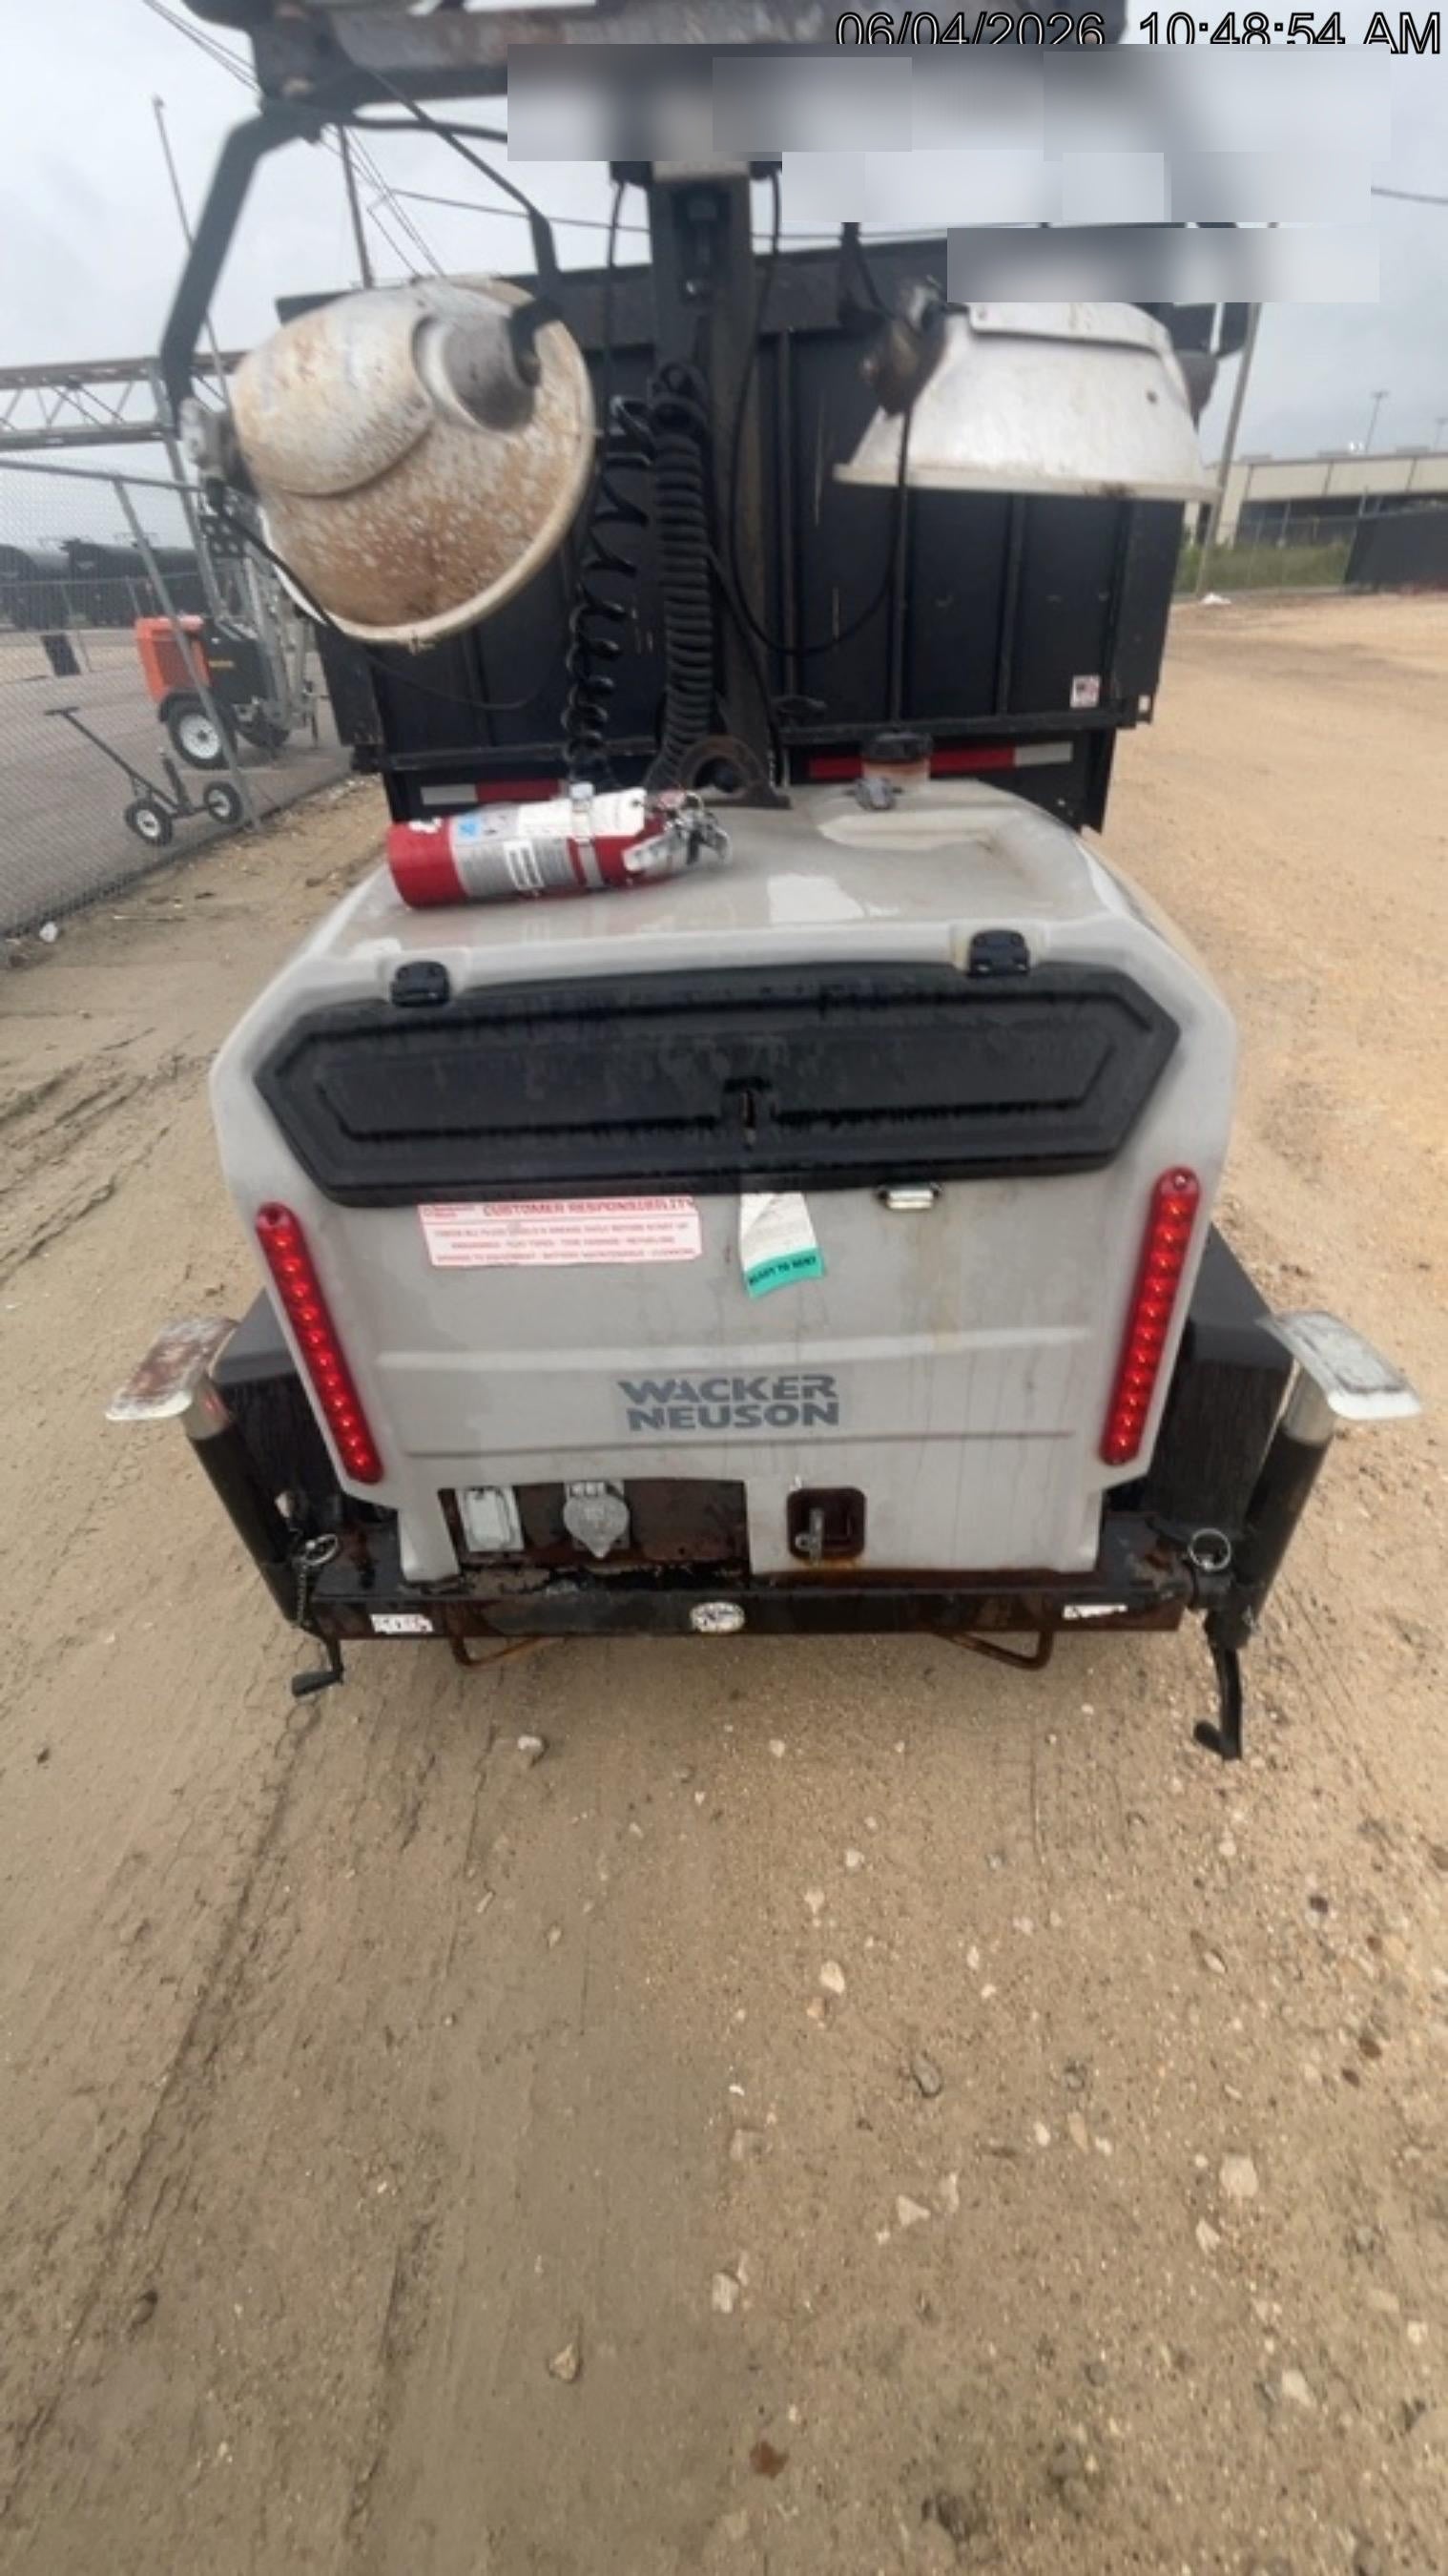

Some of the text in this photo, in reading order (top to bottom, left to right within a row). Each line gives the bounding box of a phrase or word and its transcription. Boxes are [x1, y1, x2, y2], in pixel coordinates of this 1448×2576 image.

[484, 1203, 564, 1217] CUSTOMER
[567, 1196, 695, 1214] RESPONSIBILITY
[617, 1374, 838, 1404] WACKER
[626, 1402, 839, 1431] NEUSON
